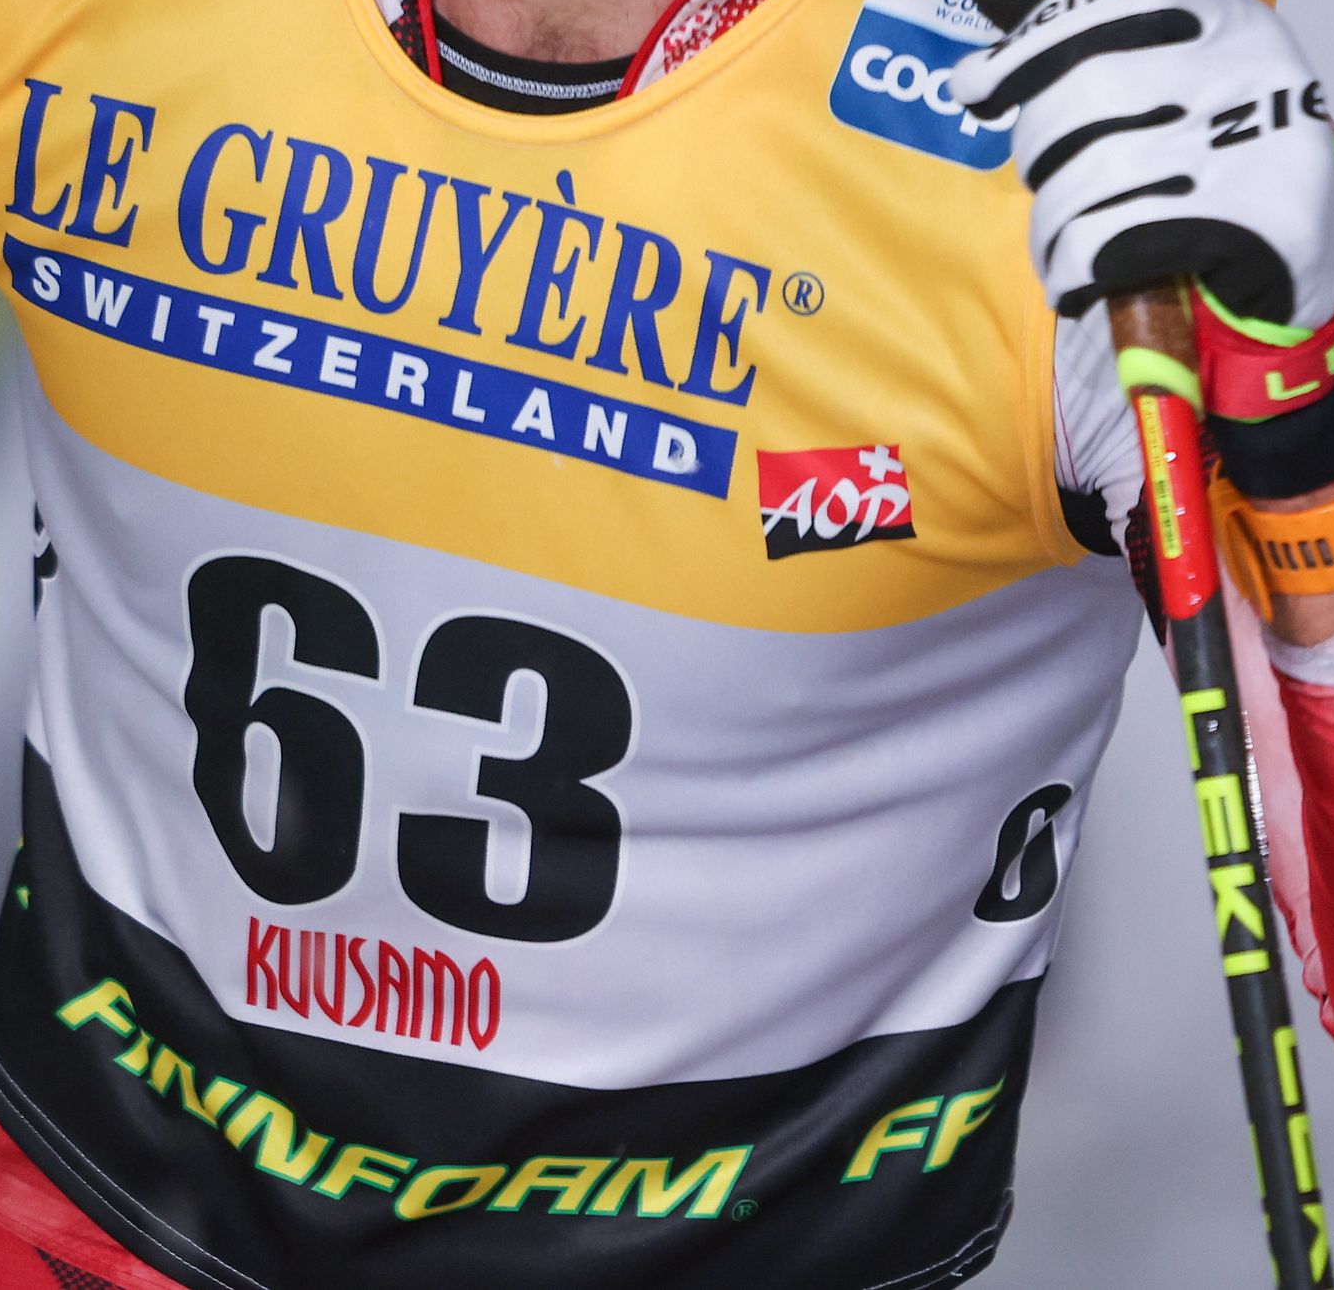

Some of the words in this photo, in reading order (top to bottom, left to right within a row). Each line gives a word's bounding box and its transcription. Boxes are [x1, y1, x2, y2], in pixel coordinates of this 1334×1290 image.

[5, 78, 157, 249] LE
[177, 121, 772, 408] GRUYÈRE
[30, 254, 705, 478] SWITZERLAND
[762, 476, 911, 544] AOP
[183, 555, 633, 943] 63
[1180, 688, 1271, 978] LEKI
[55, 975, 756, 1222] FINNFOAM
[245, 915, 502, 1052] KUUSAMO
